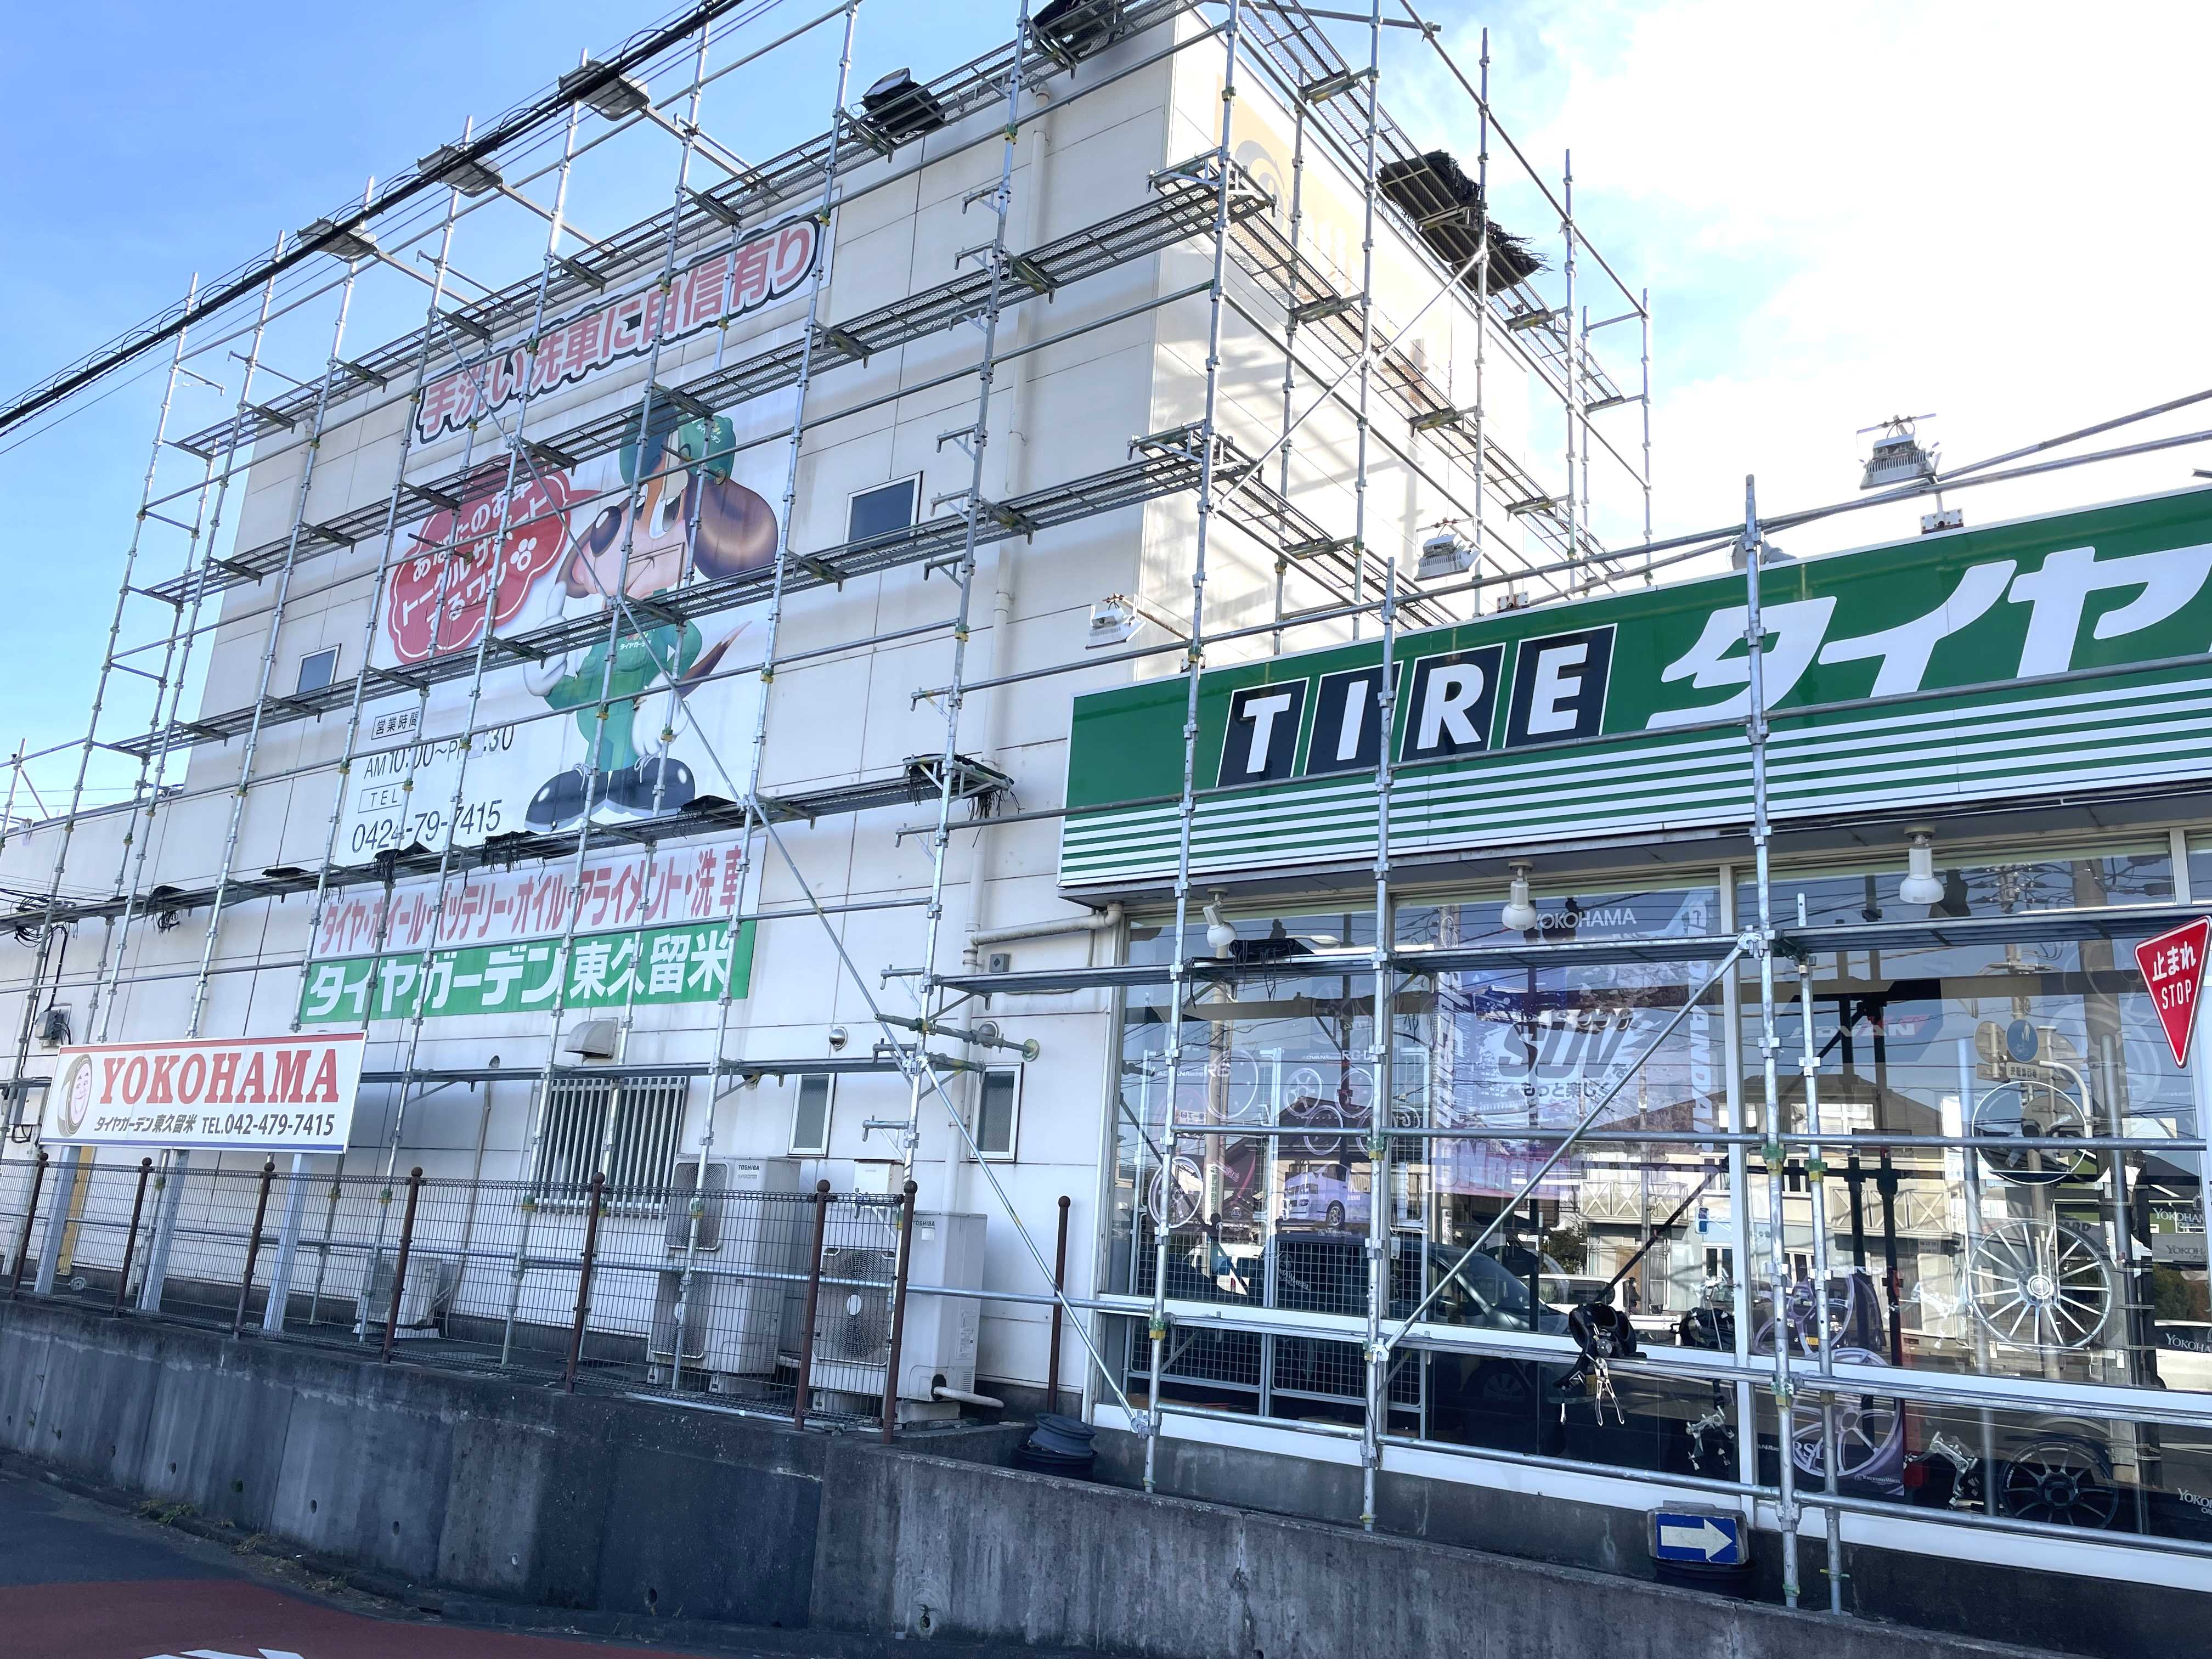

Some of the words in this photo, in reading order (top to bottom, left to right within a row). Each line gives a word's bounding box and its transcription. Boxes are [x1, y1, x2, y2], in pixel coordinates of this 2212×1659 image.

[1242, 642, 1589, 774] TIRE
[370, 788, 398, 808] TEL
[2152, 940, 2197, 982] 止まれ
[2162, 979, 2192, 1009] STOP
[1688, 900, 1714, 1152] GOLANDAR
[99, 1048, 340, 1105] YOKOHAMA
[93, 1114, 198, 1134] タイヤガーデン東久留米
